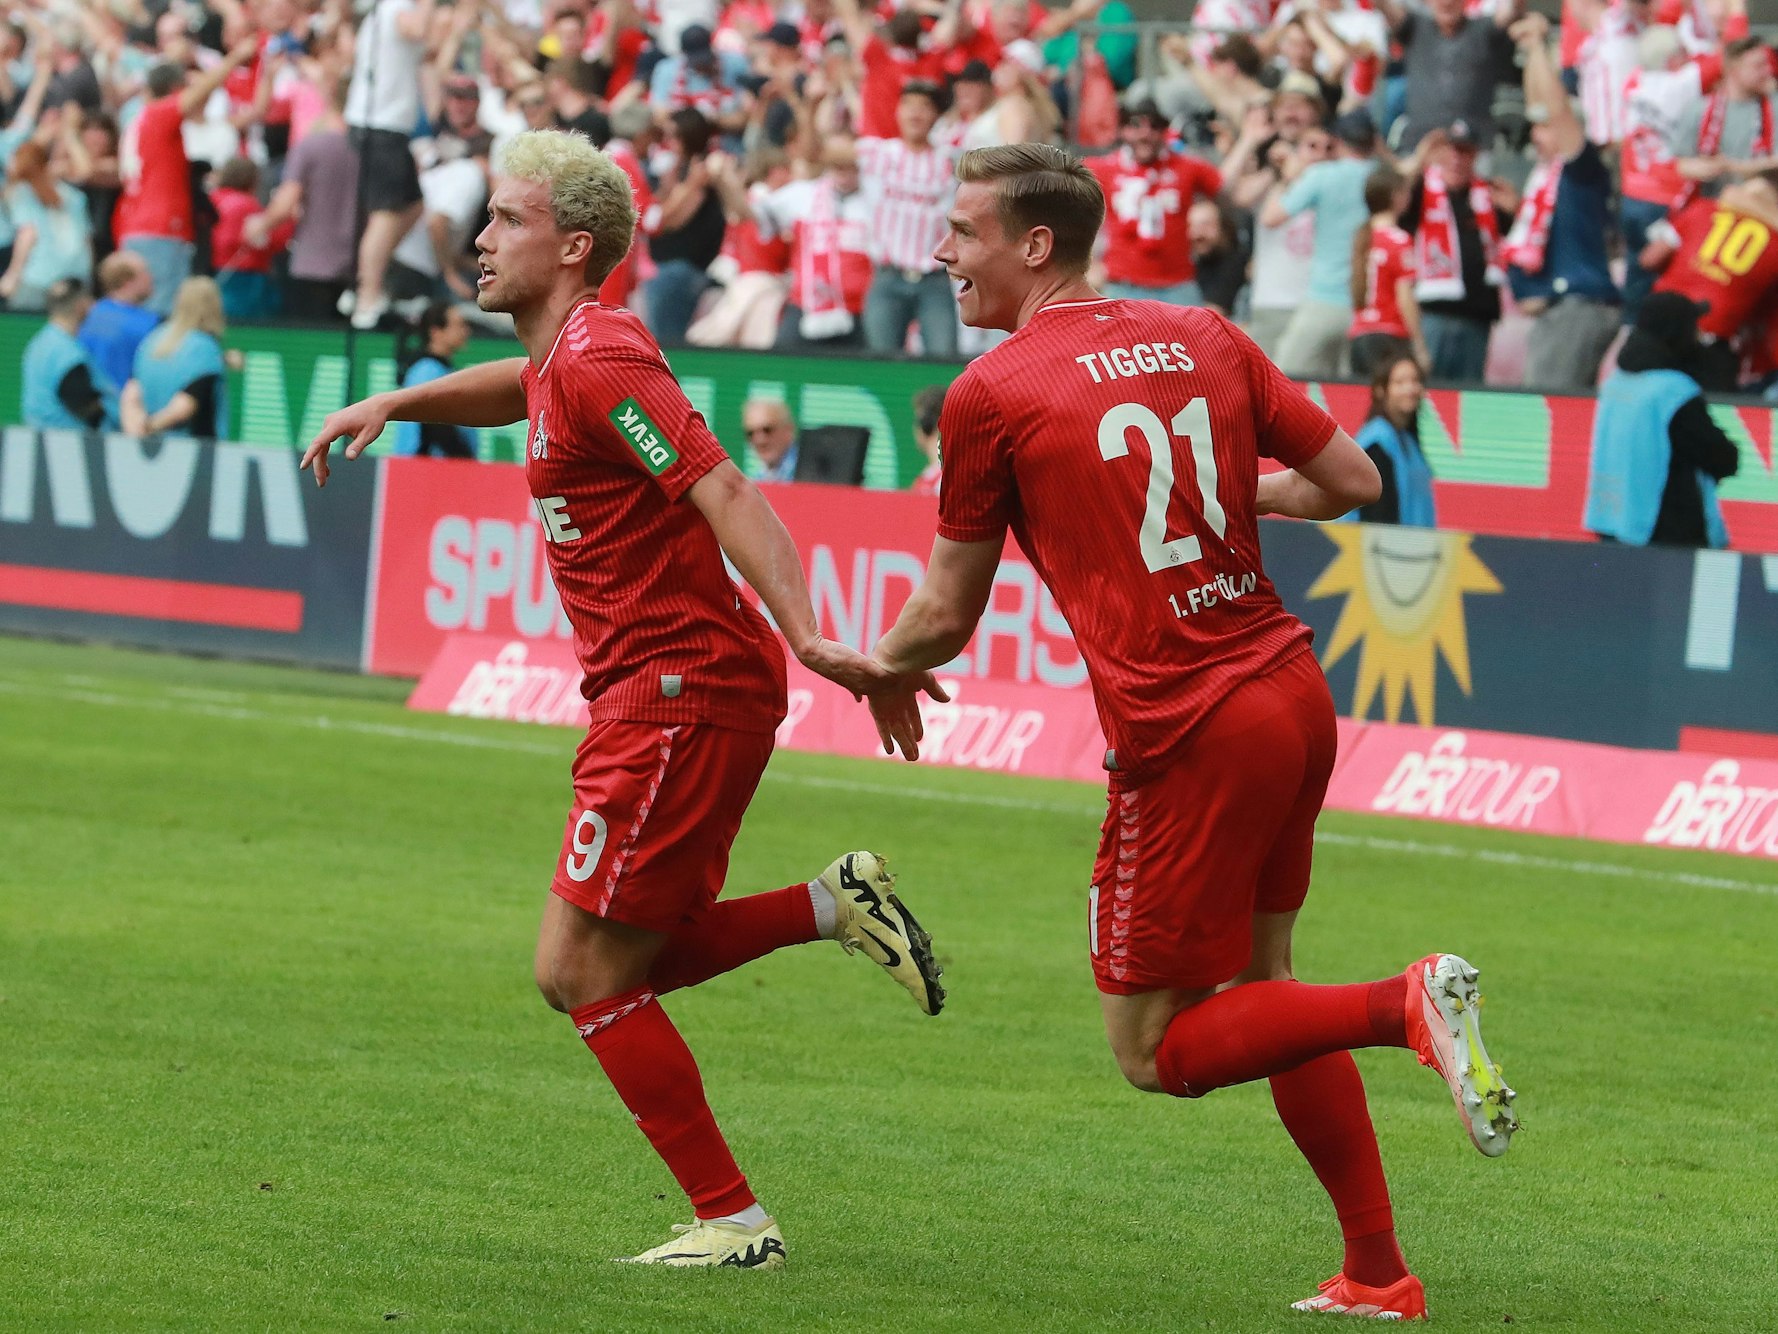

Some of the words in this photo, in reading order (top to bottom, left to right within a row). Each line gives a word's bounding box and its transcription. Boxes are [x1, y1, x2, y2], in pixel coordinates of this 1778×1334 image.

[1700, 211, 1770, 276] 10
[1075, 342, 1195, 383] TIGGES
[618, 407, 670, 467] DEVK
[1098, 397, 1230, 573] 21
[1187, 583, 1218, 613] FC
[1212, 572, 1257, 601] ÖLN
[876, 703, 1045, 772] ERTOUR
[1373, 751, 1561, 827] DERTOUR
[566, 809, 608, 882] 9
